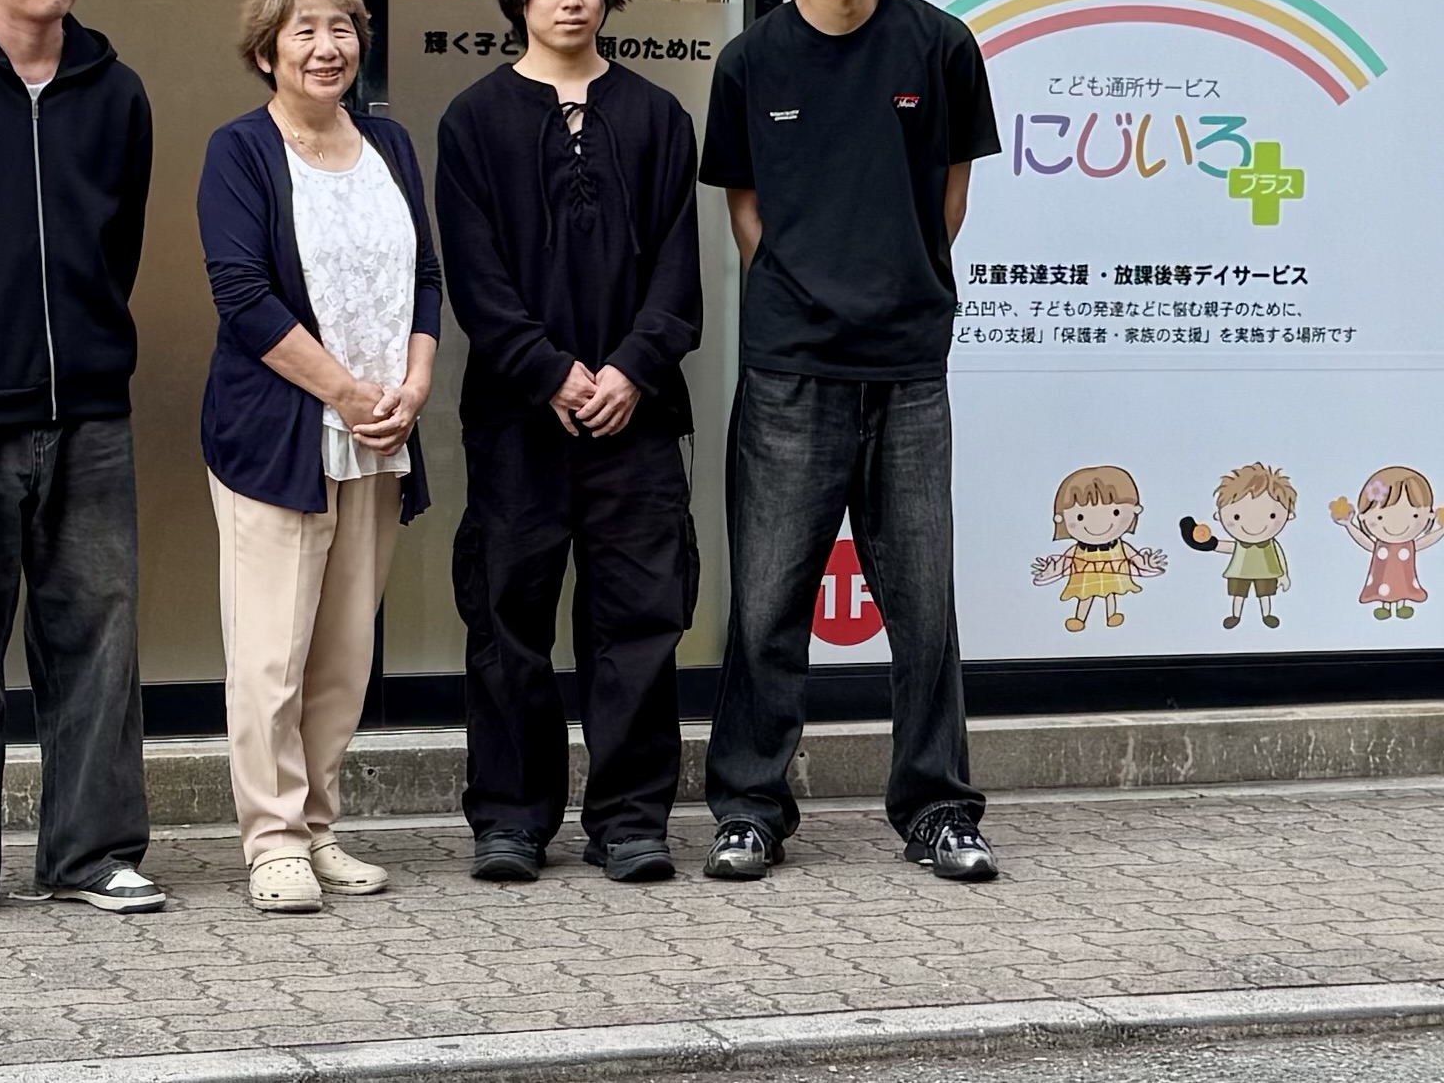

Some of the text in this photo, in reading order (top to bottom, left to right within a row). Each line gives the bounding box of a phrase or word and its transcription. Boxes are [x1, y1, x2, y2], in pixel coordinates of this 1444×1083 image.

[1048, 75, 1221, 99] こども通所サービス
[1013, 112, 1253, 179] にじいろ
[1239, 173, 1295, 195] プラス
[968, 264, 1310, 286] 児童発達支援・放課後等デイサービス
[952, 326, 1358, 346] どもの支援」「保護者・家族の支援」を実施する場所です
